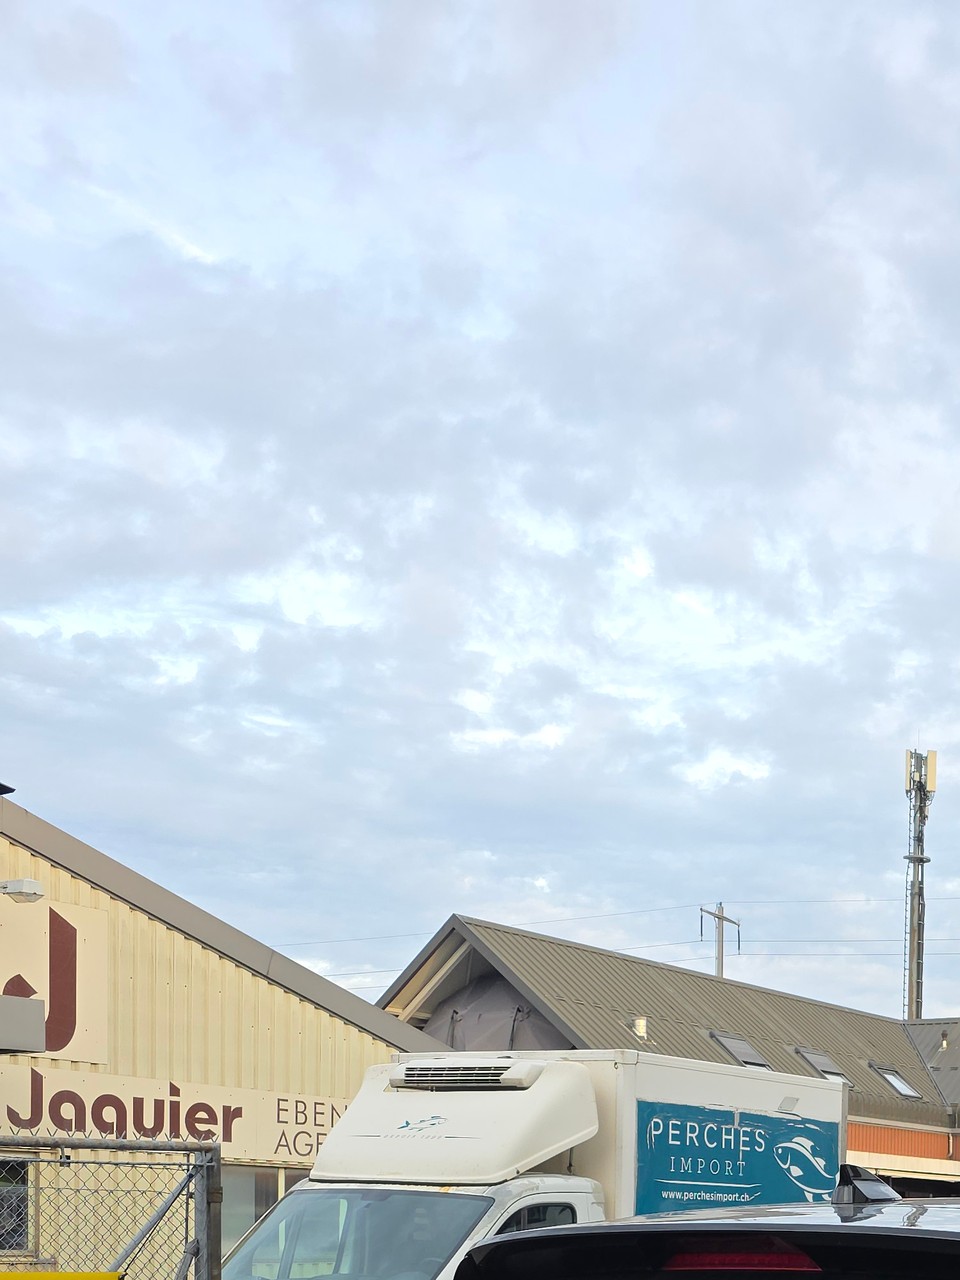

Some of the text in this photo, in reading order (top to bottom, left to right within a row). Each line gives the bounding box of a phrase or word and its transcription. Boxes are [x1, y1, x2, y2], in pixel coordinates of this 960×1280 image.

[7, 1067, 242, 1143] Jaquier
[650, 1118, 766, 1152] PERCHES
[670, 1156, 746, 1177] IMPORT
[661, 1190, 750, 1203] www.perchesimport.ch
